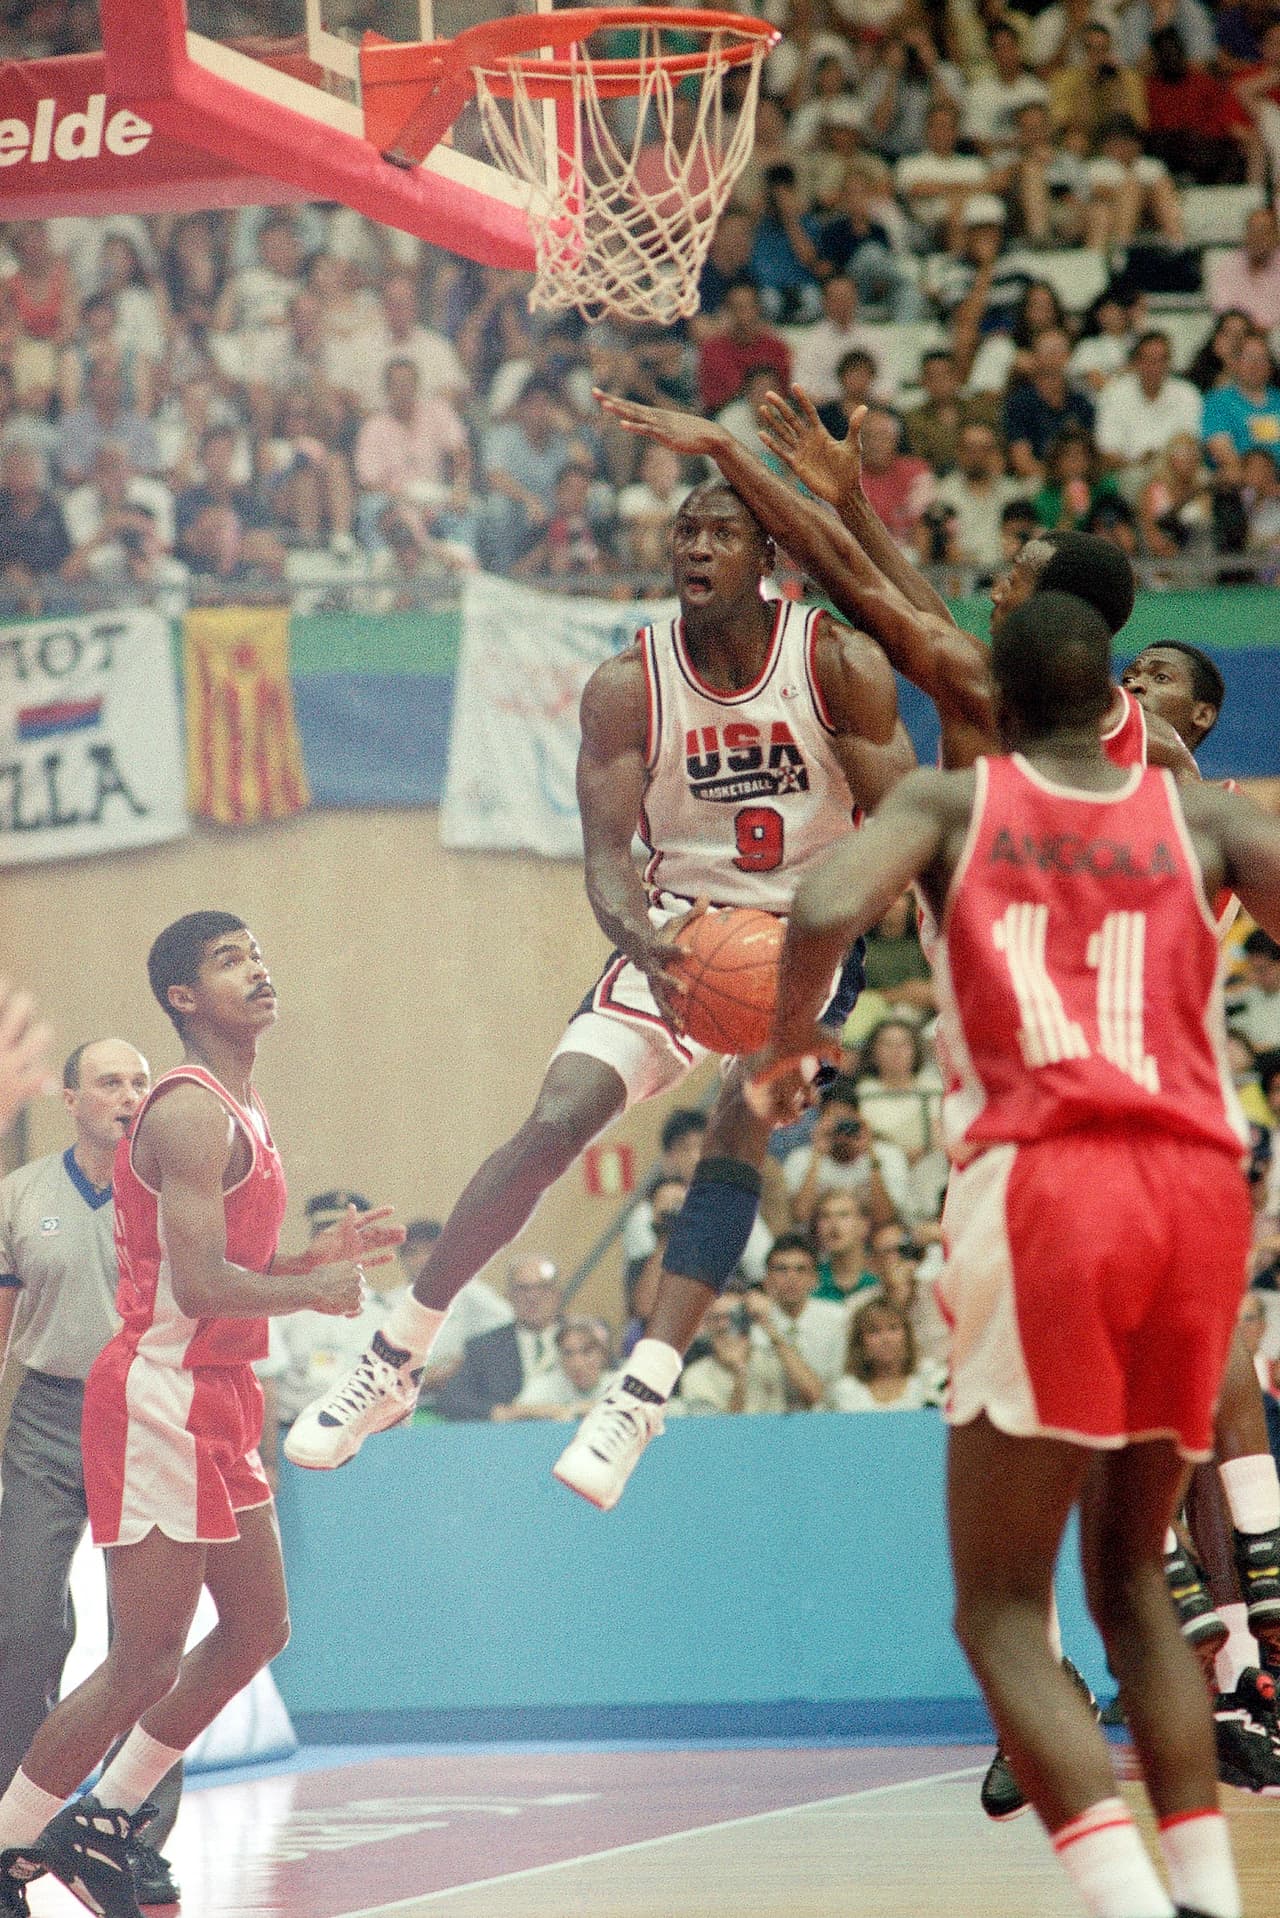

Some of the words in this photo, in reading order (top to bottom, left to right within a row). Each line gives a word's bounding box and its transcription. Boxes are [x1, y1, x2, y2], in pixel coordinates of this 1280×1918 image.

[0, 93, 153, 167] elde
[686, 721, 804, 780] USA
[700, 779, 773, 799] BASKETBALL
[731, 806, 784, 873] 9
[989, 826, 1177, 880] ANGOLA
[991, 901, 1161, 1095] 11
